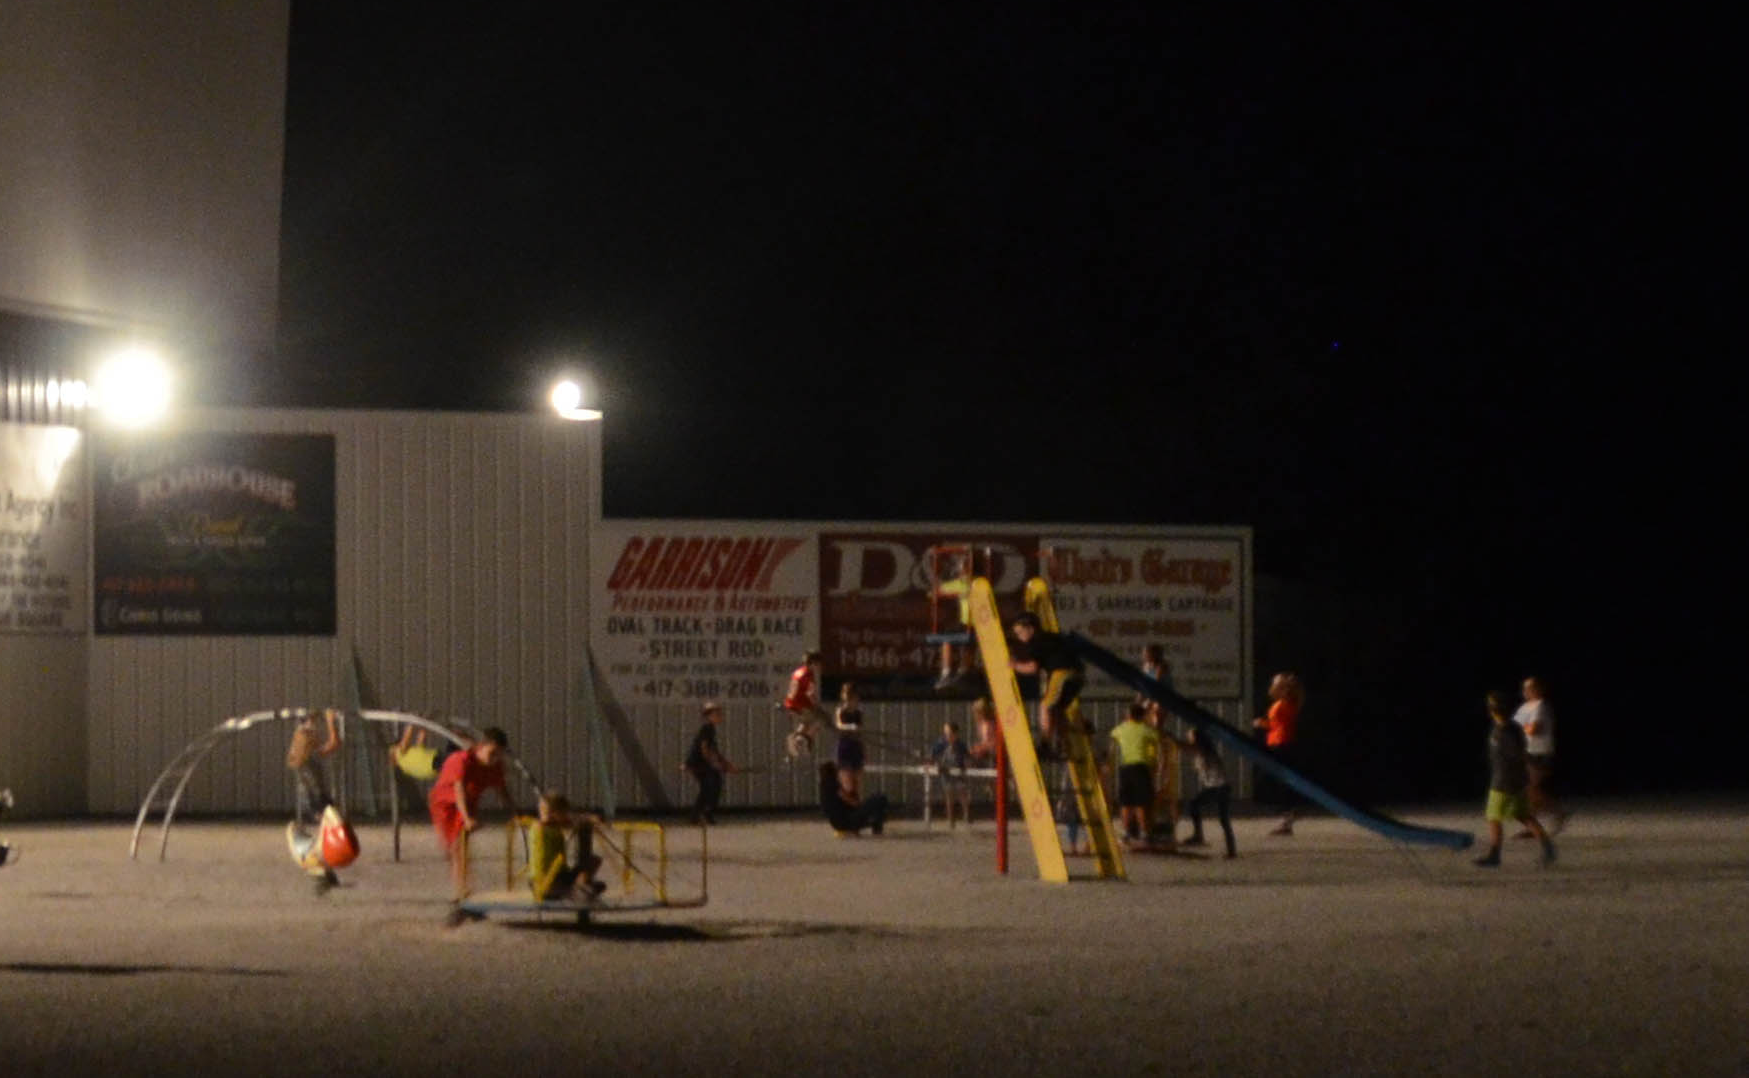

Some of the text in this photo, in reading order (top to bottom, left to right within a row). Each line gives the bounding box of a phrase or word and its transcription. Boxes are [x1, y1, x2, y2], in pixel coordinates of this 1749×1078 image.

[607, 536, 790, 591] GARRISON
[607, 616, 805, 636] OVAL TRACK DRAG RACE
[649, 640, 766, 659] STREET ROD
